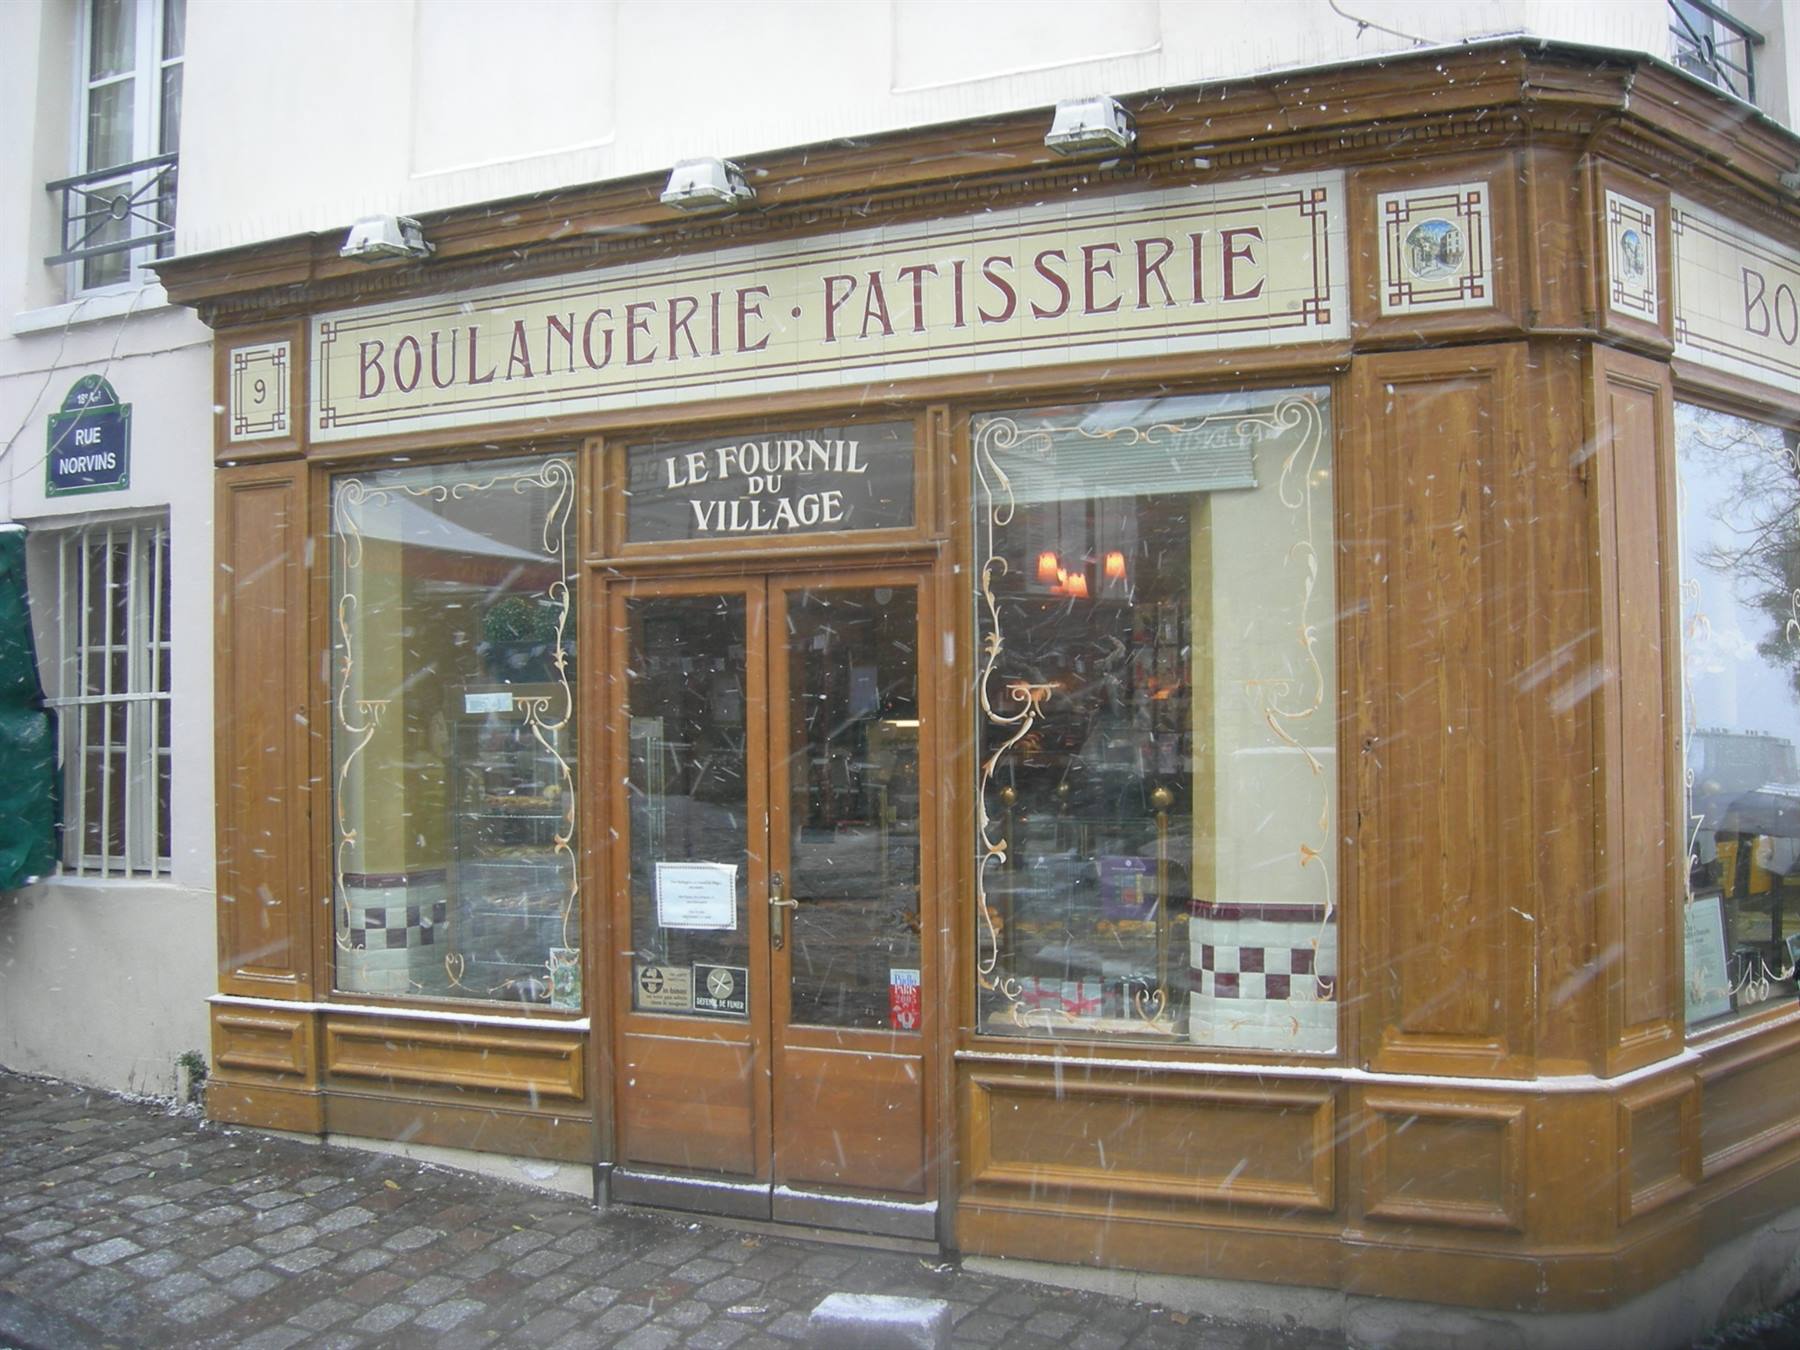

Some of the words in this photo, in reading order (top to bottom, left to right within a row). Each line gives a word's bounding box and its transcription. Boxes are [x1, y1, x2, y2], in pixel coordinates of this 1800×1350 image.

[358, 285, 770, 400] BOULANGERIE
[822, 226, 1266, 343] PATISSERIE
[1741, 266, 1799, 346] BO
[253, 379, 266, 404] 9
[75, 427, 102, 446] RUE
[59, 452, 117, 475] NORVINS
[666, 451, 710, 489] LE
[716, 439, 868, 480] FOURNIL
[748, 475, 782, 494] DU
[690, 490, 844, 531] VILLAGE
[719, 999, 727, 1008] DE
